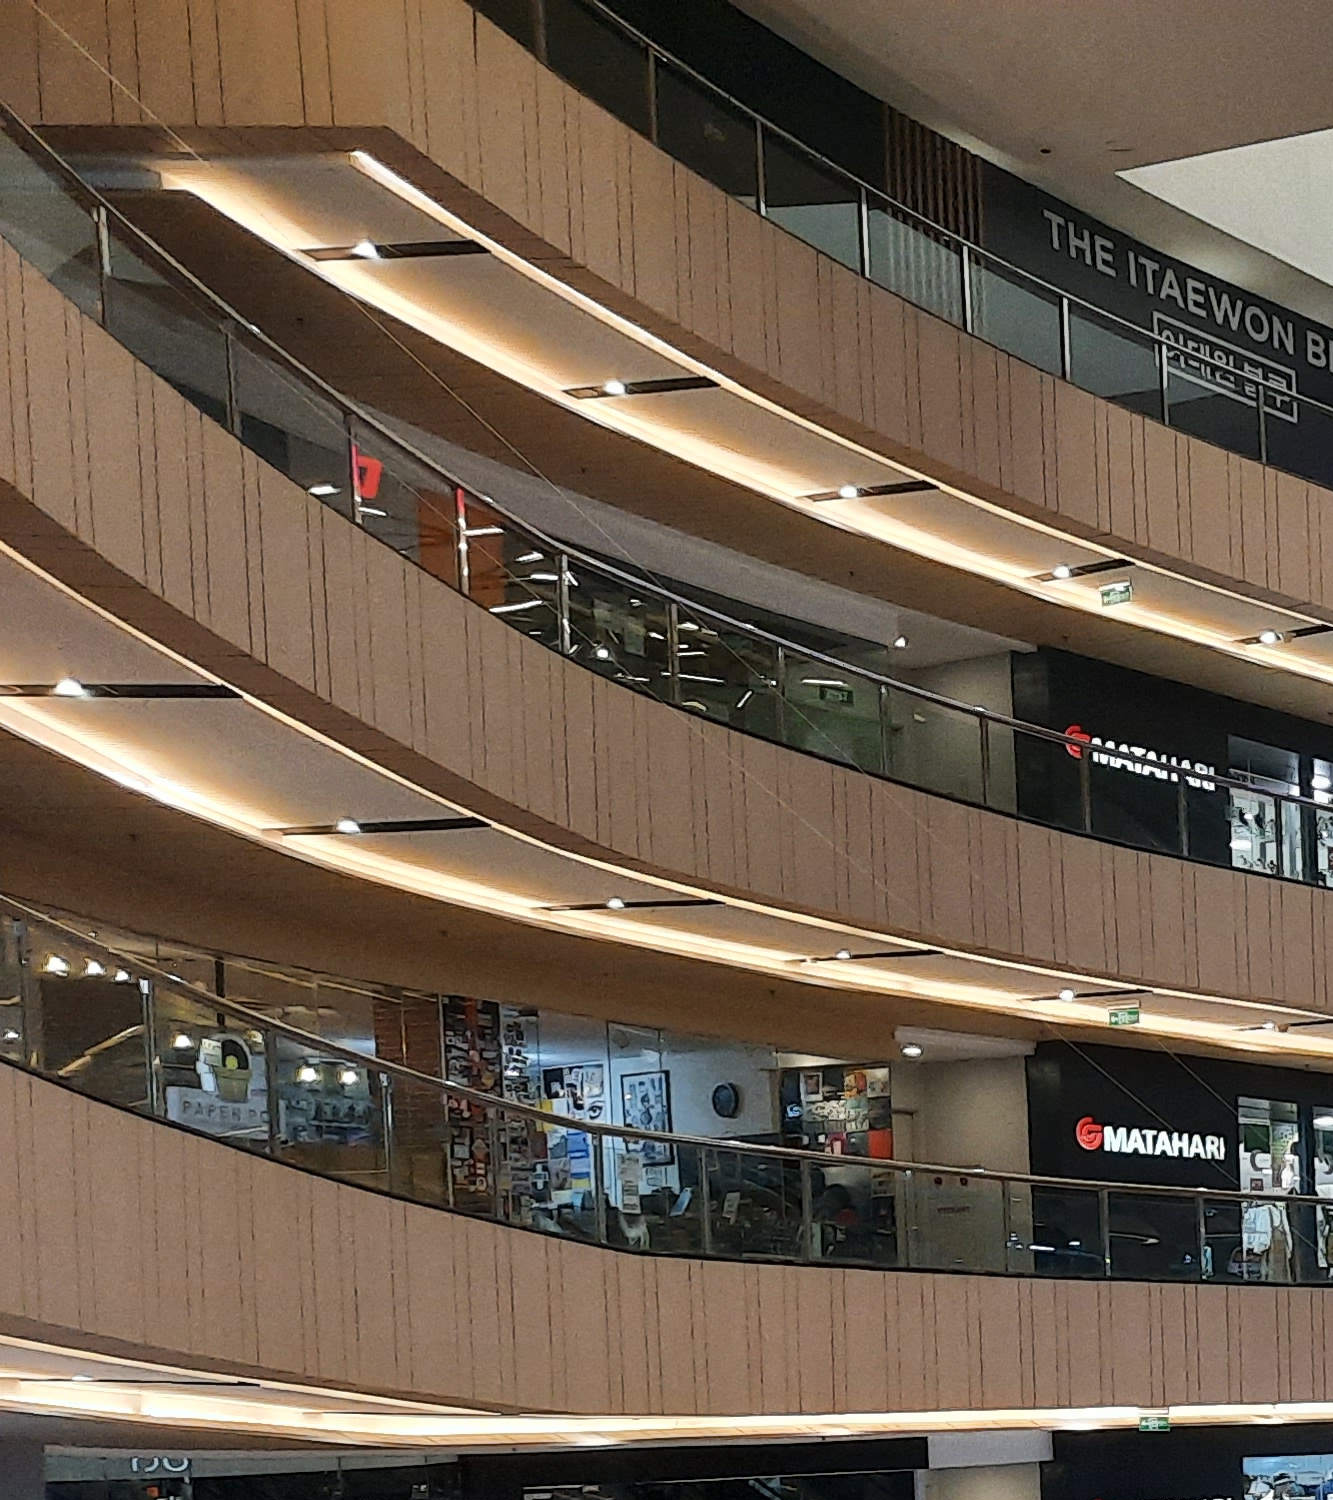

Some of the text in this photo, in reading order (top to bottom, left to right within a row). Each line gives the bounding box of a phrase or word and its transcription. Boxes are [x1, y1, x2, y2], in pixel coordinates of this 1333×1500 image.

[1042, 208, 1117, 278] THE
[1127, 250, 1295, 356] ITAEWON
[1103, 1125, 1226, 1160] MATAHARI
